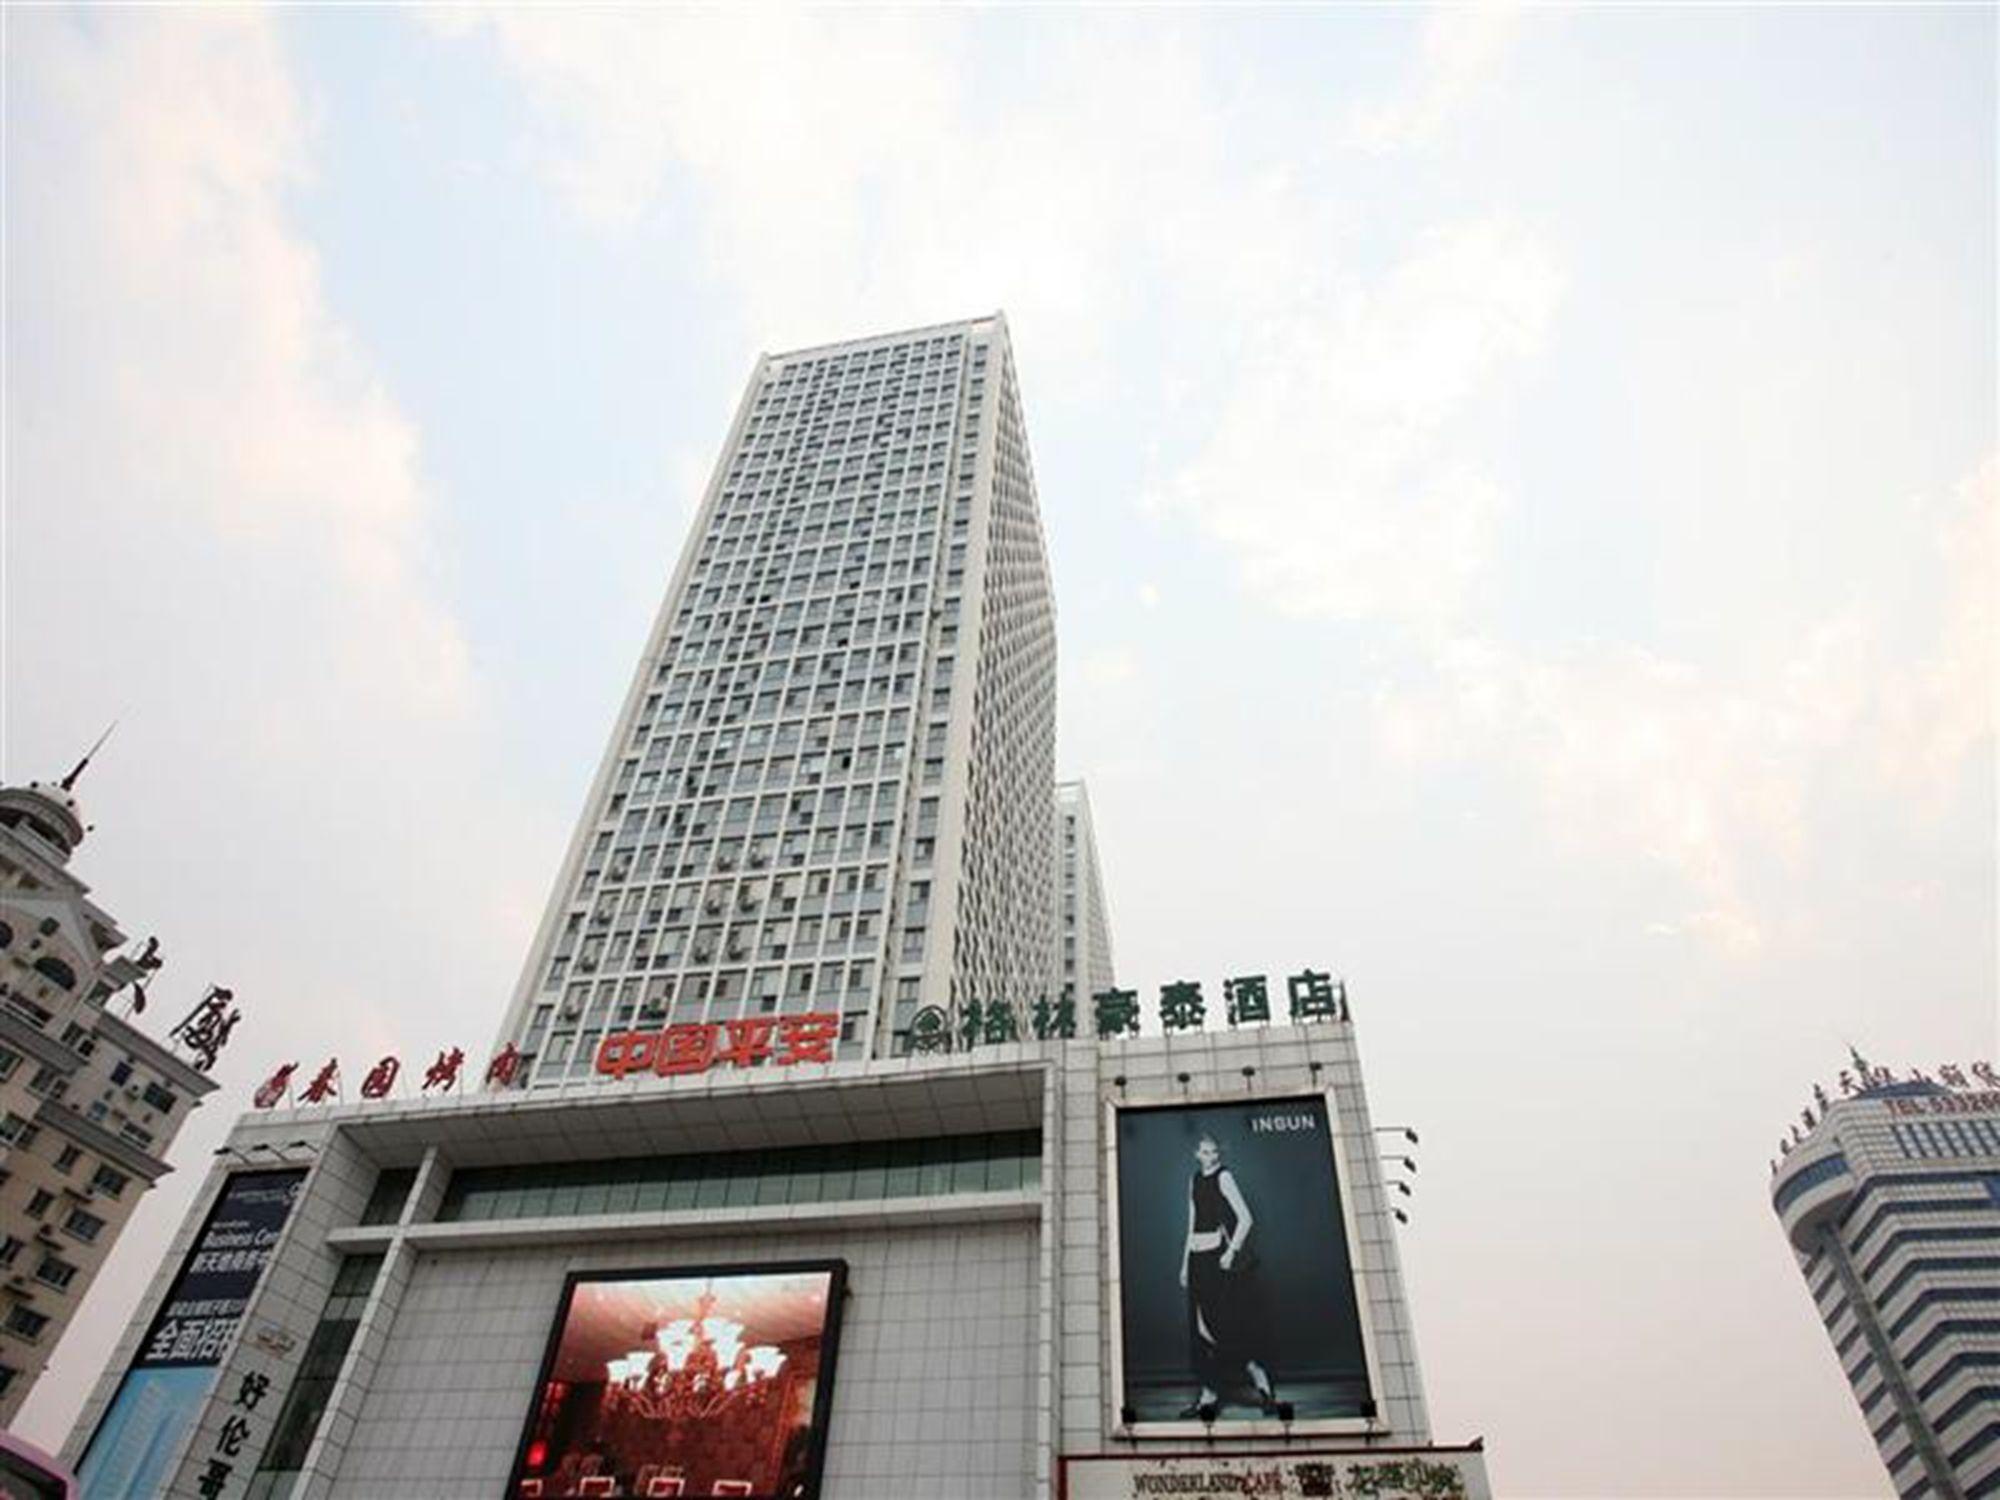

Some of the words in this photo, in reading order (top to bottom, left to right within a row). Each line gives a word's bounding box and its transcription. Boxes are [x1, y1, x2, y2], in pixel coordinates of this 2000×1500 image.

[597, 1012, 840, 1079] 中国平安
[962, 969, 1337, 1050] 格林豪泰酒店
